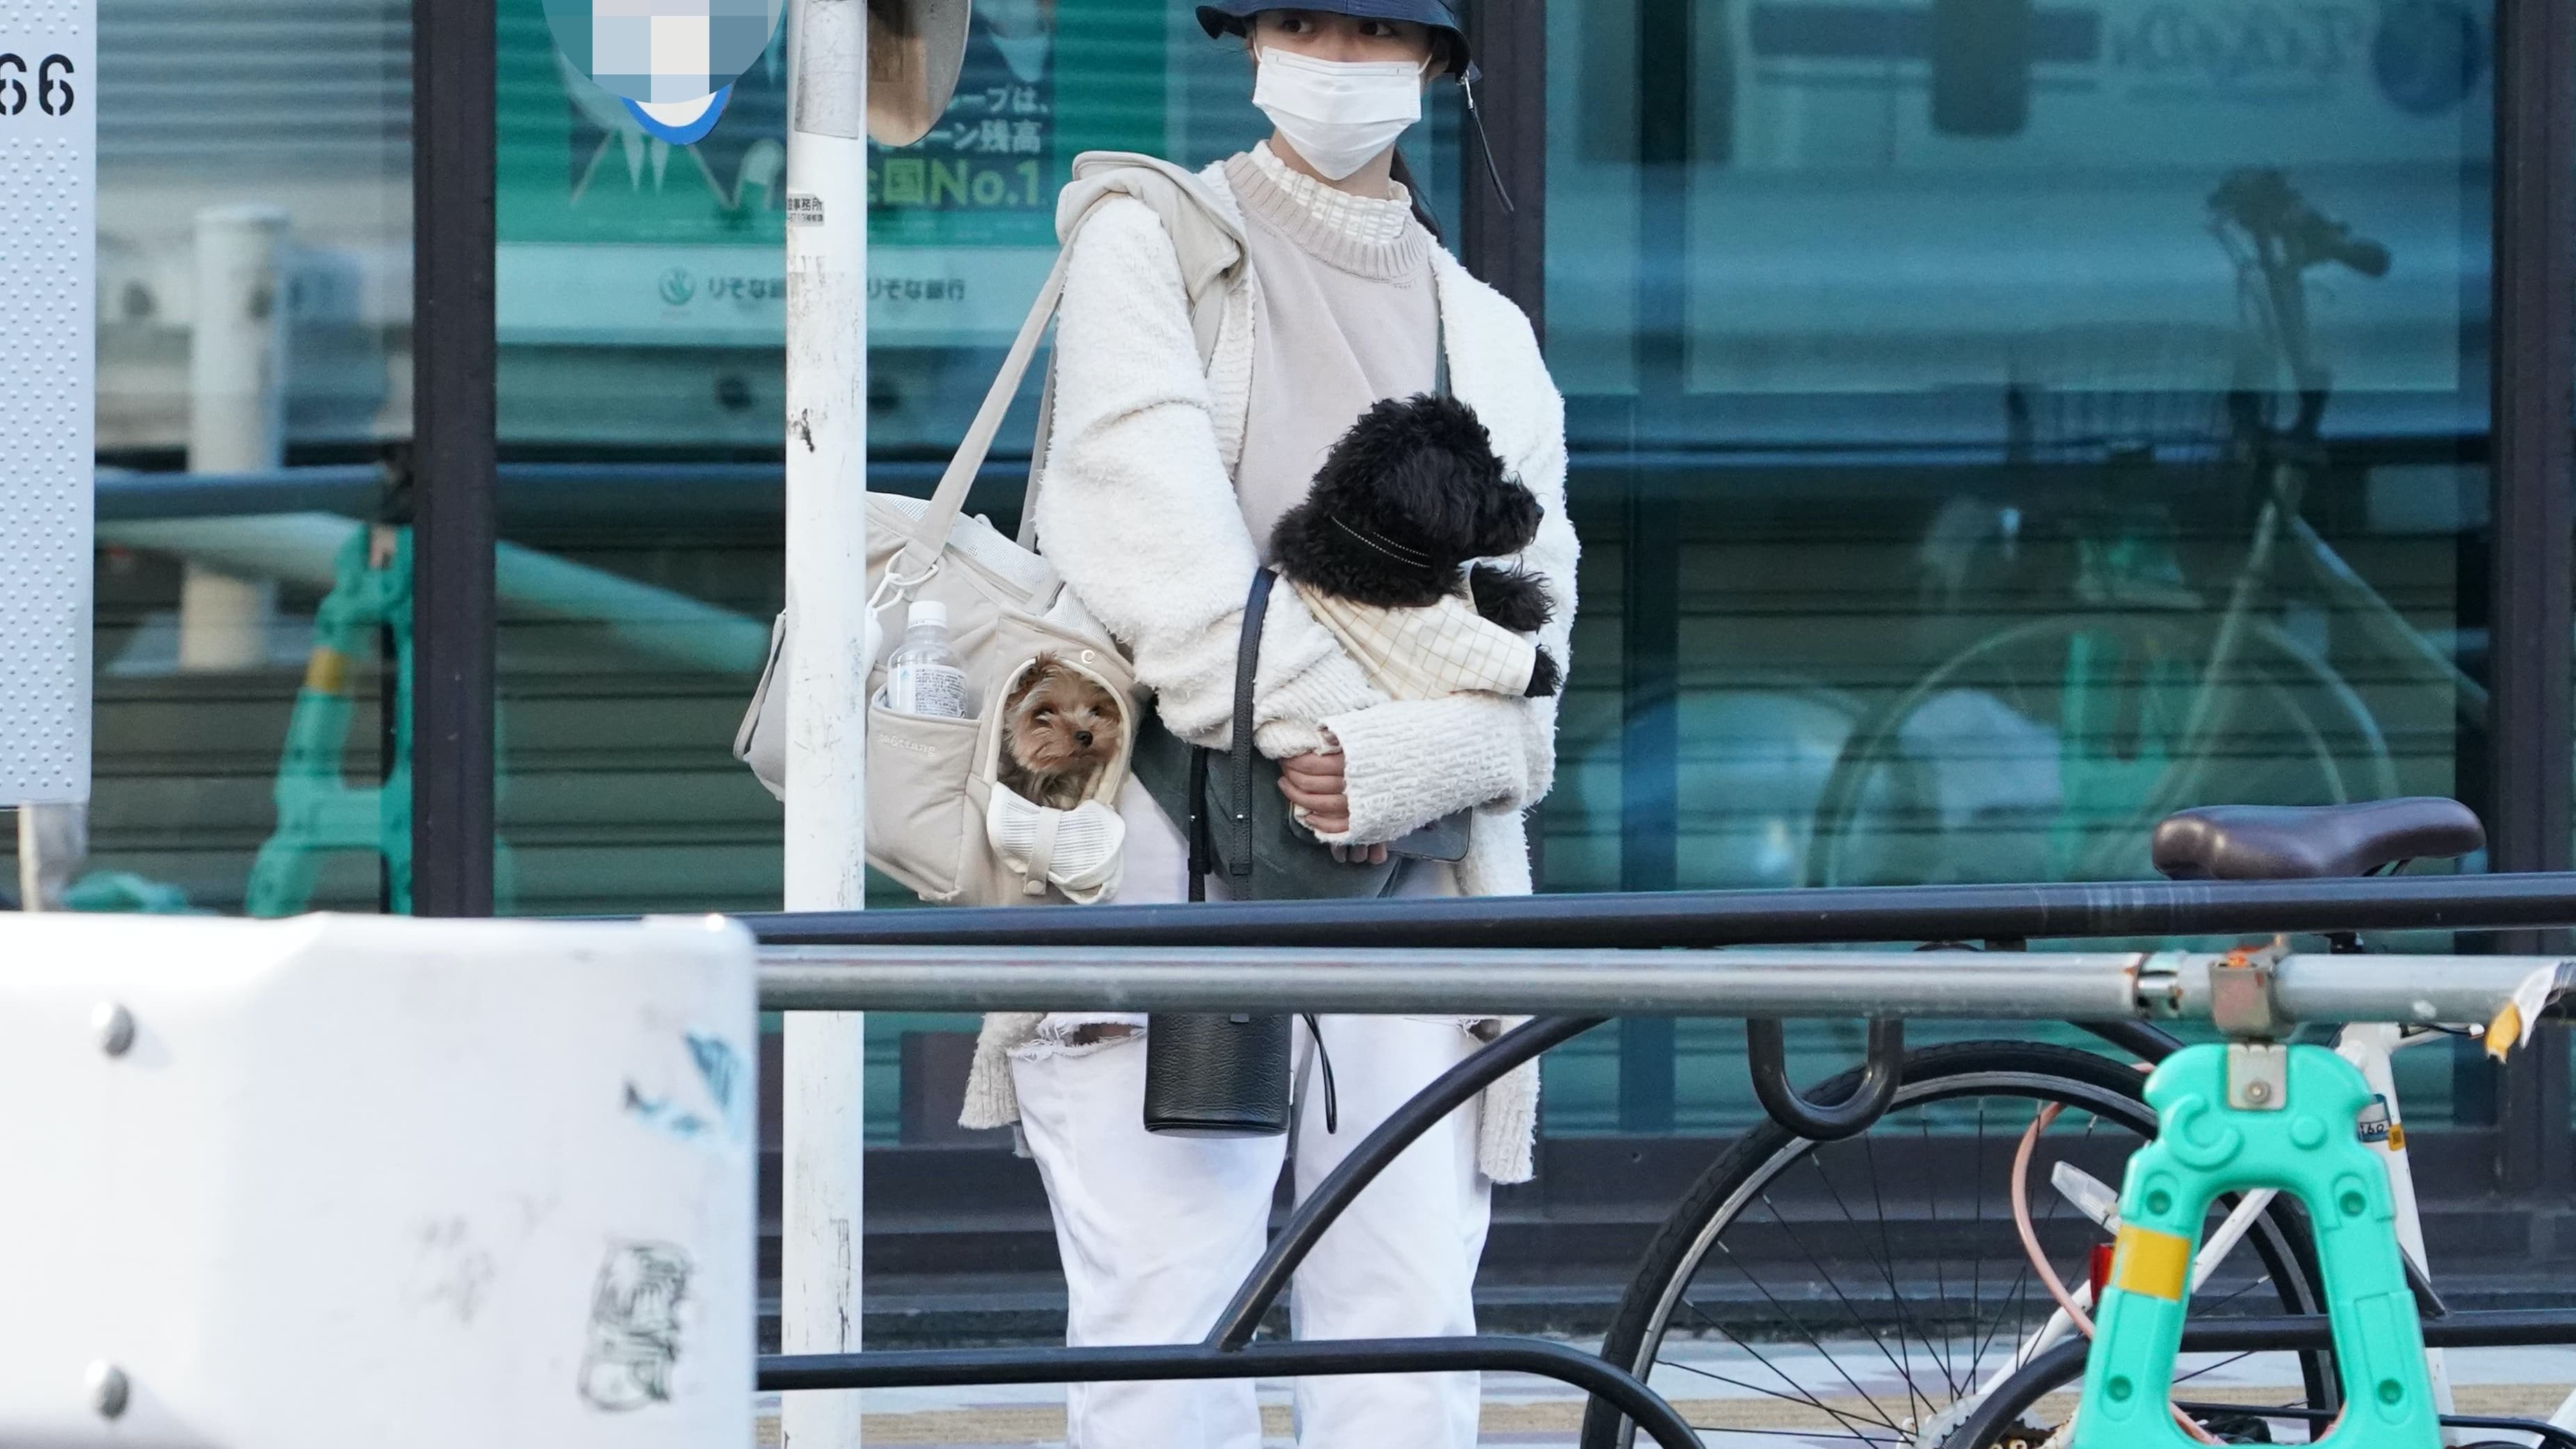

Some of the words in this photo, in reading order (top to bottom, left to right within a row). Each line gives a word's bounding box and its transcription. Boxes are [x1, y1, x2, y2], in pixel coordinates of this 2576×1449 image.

[0, 53, 74, 116] 66
[912, 118, 1042, 154] ーン残高
[867, 157, 1040, 207] 国No.1
